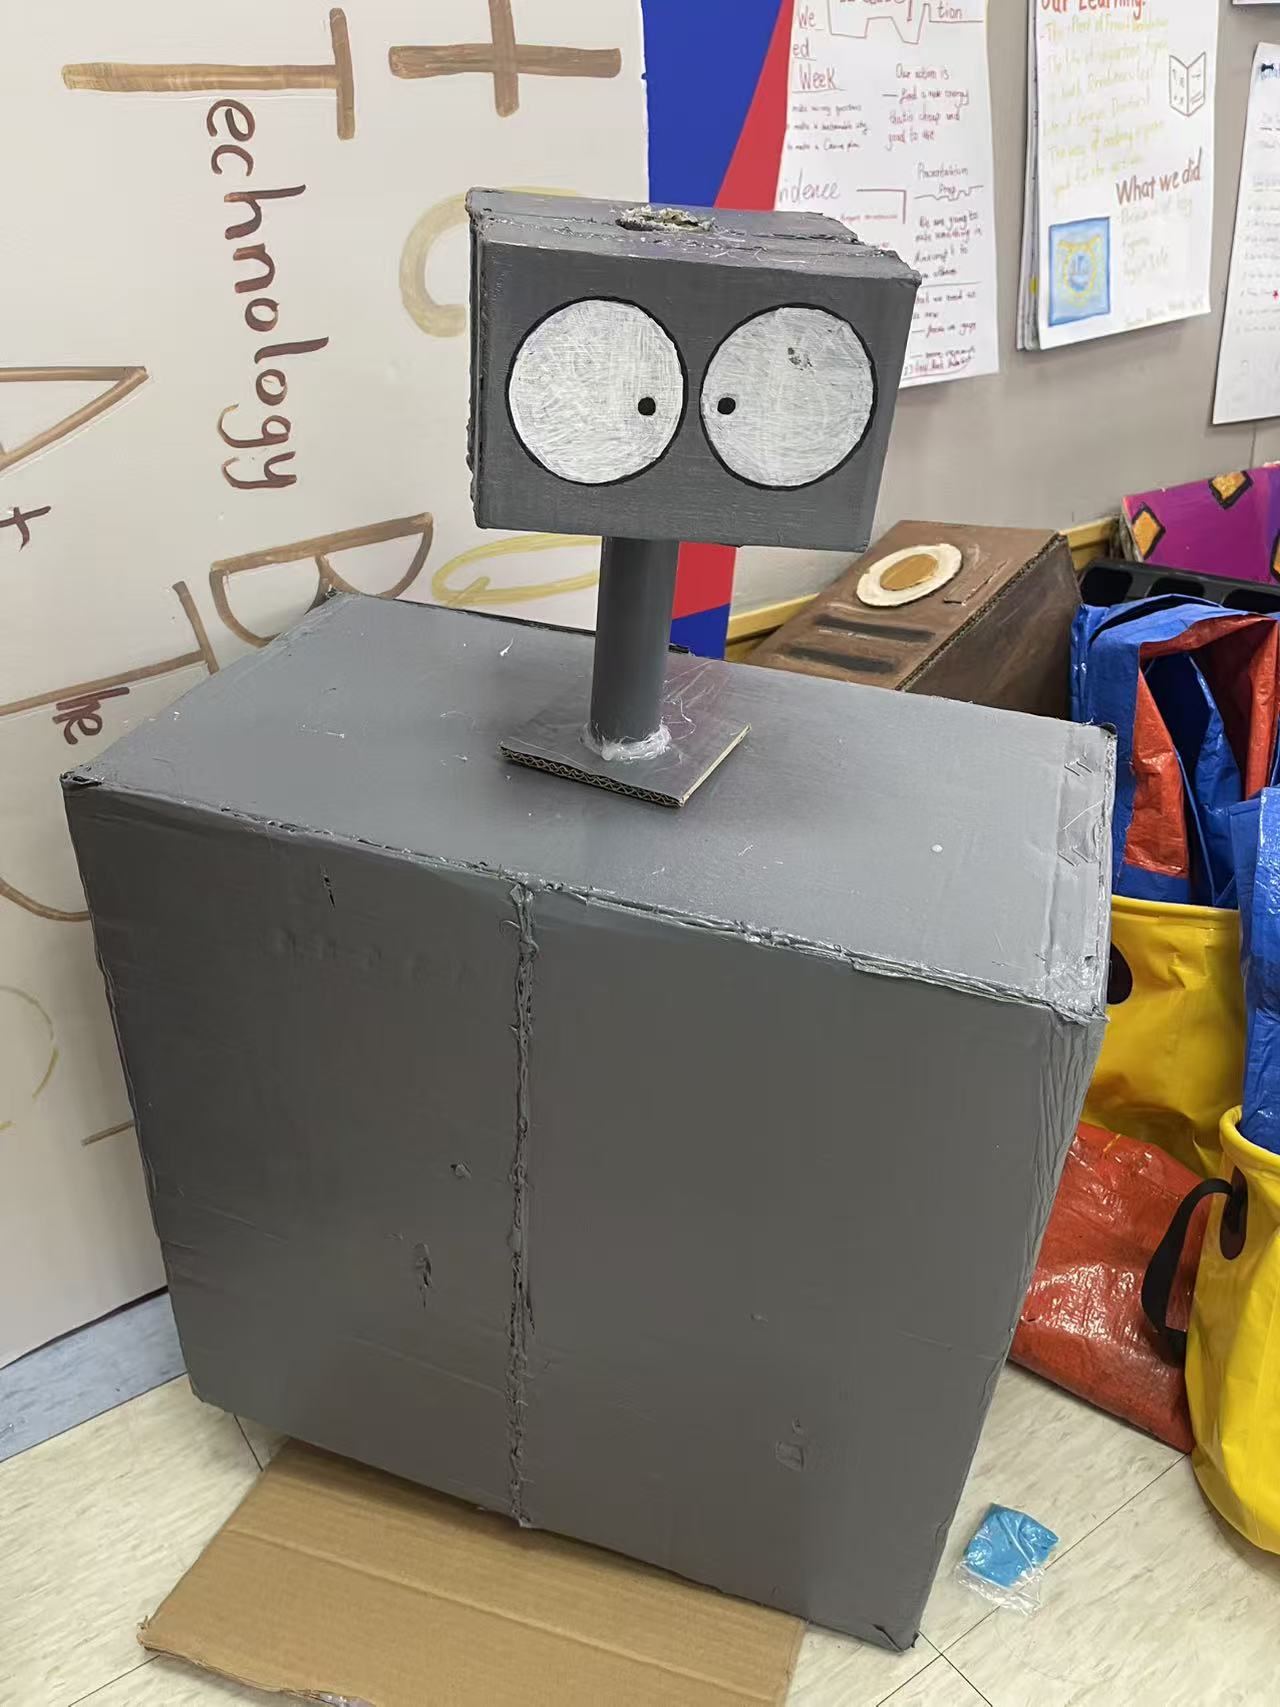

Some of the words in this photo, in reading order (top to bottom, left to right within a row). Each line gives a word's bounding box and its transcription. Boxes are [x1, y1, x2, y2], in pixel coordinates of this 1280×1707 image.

[797, 5, 816, 28] We
[792, 37, 809, 57] ed
[1115, 175, 1156, 206] What
[1159, 171, 1179, 193] we
[1182, 146, 1202, 184] did
[61, 7, 356, 490] Technology
